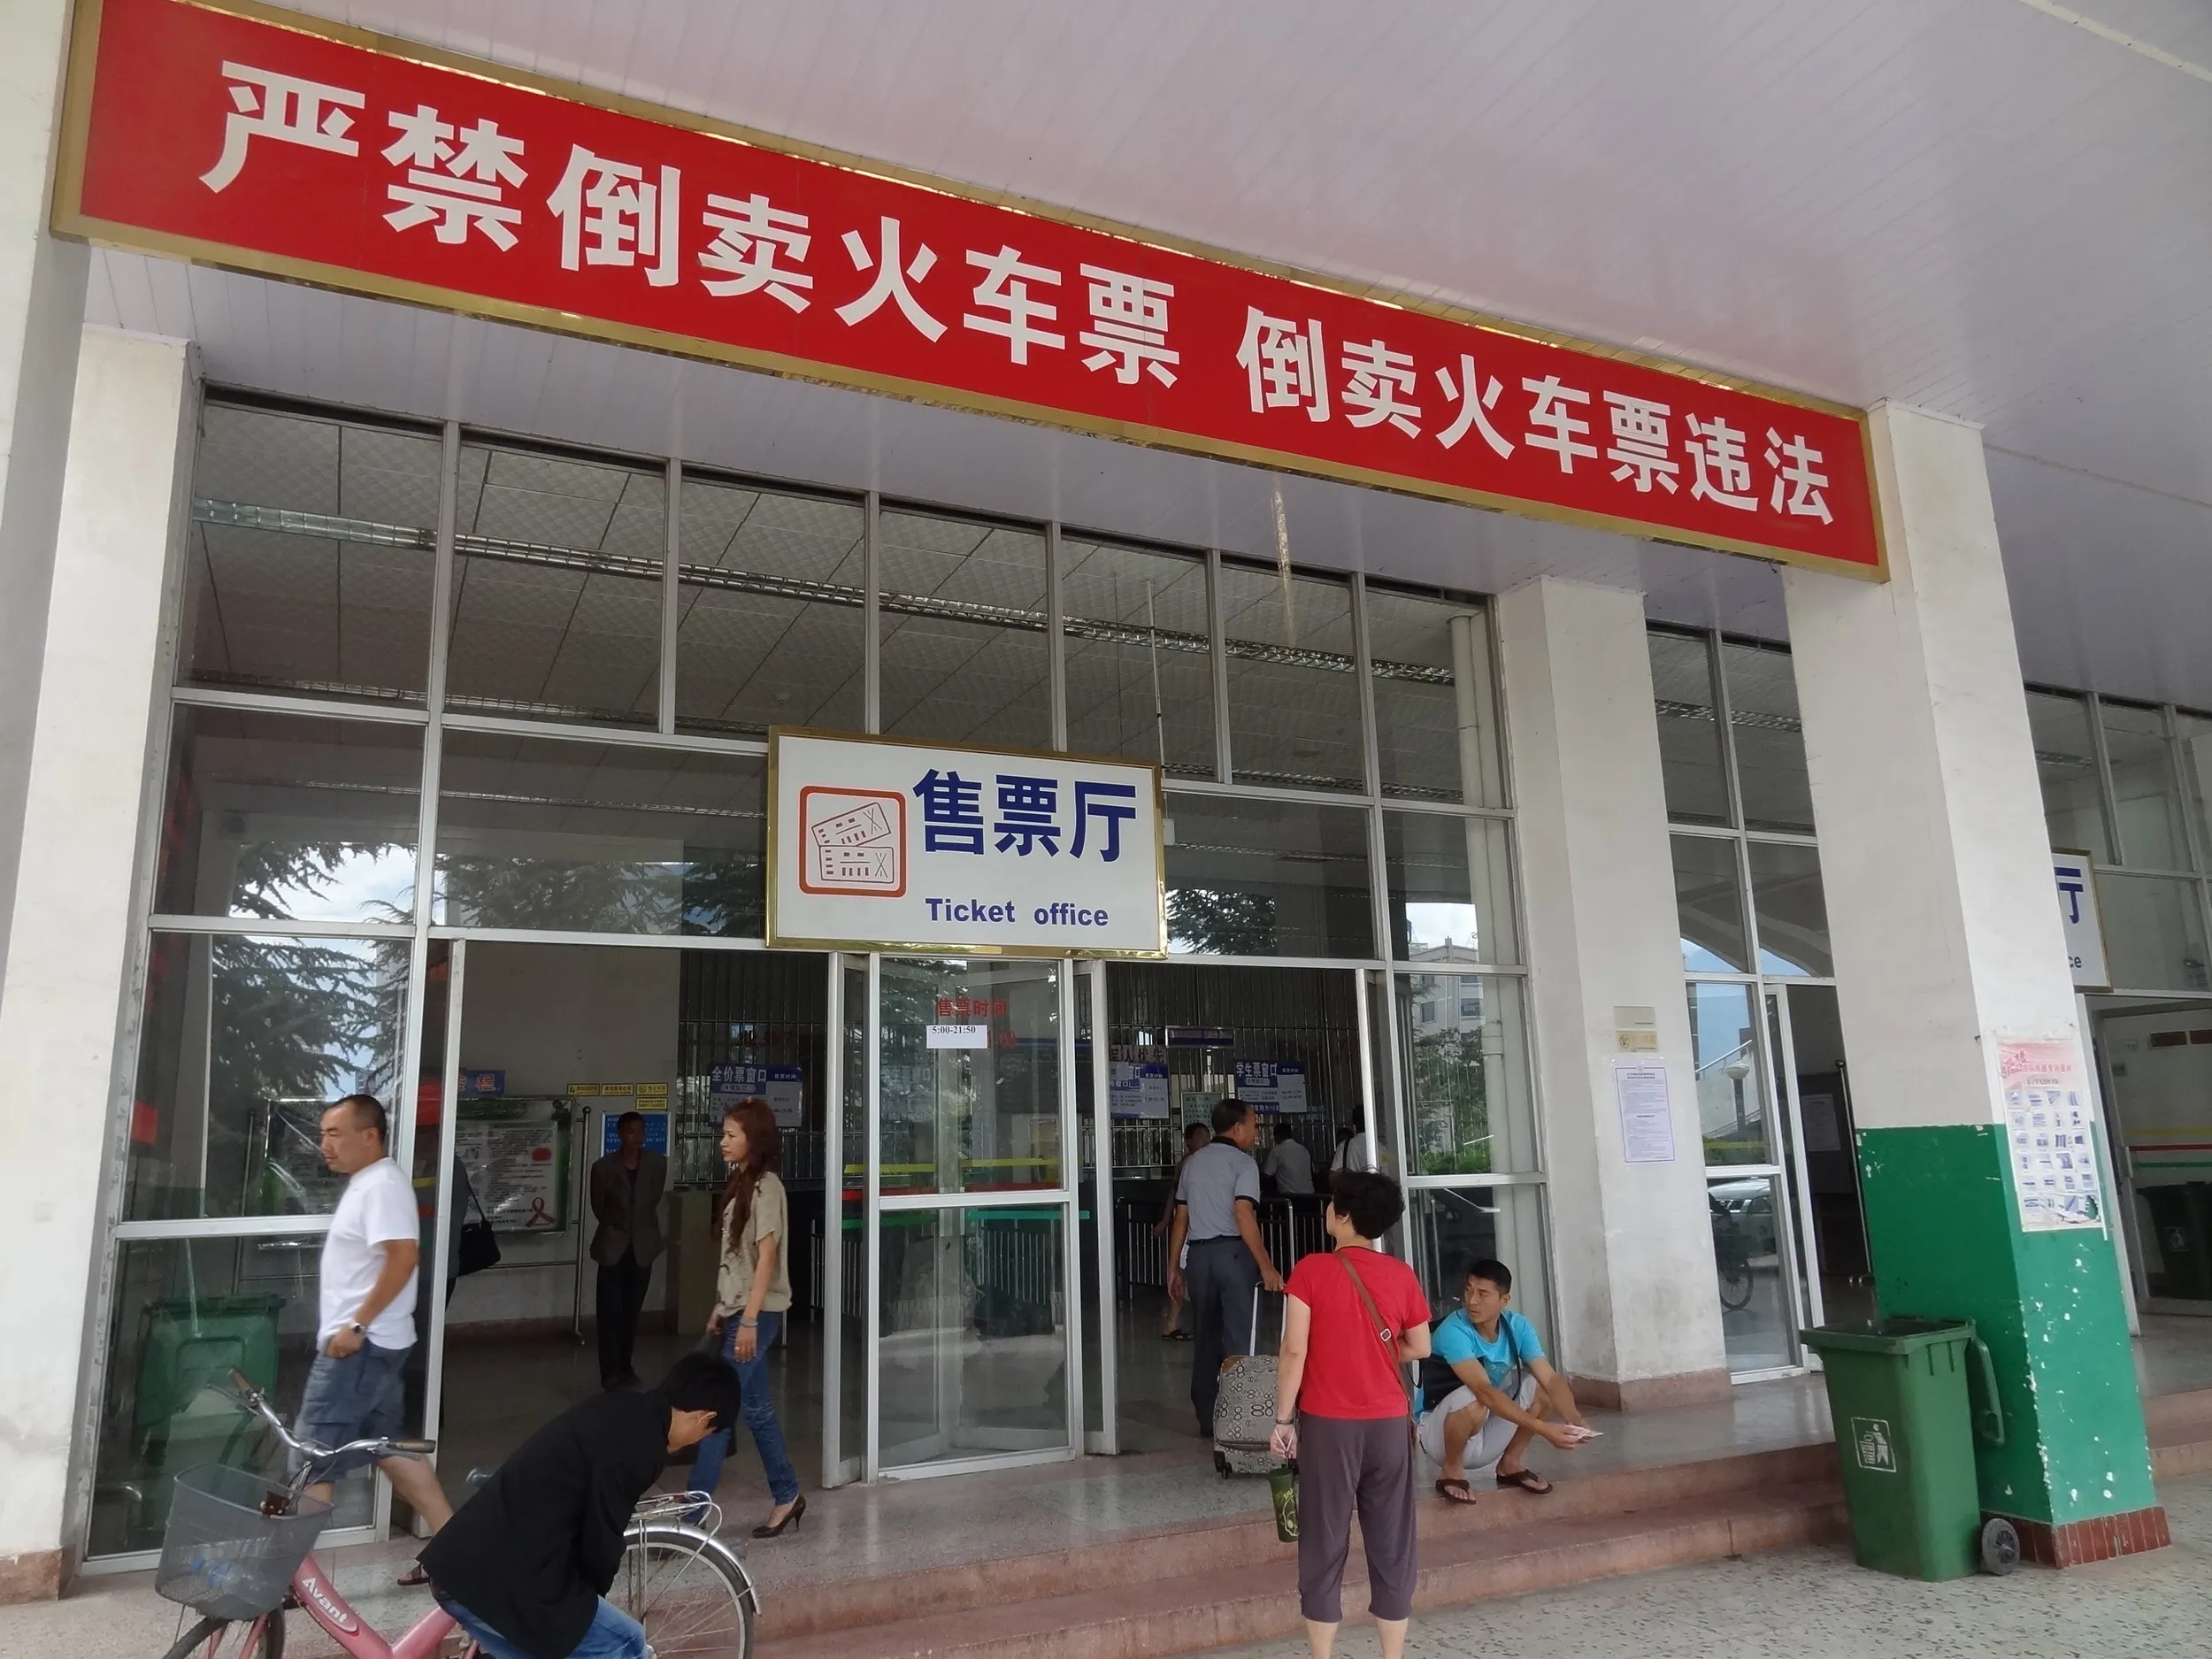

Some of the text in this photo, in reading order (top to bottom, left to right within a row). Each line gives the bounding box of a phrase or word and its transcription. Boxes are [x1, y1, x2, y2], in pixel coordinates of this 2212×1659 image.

[199, 60, 1833, 525] 严禁倒卖火车票 倒卖火车票违法
[912, 768, 1136, 862] 售票厅
[925, 897, 1109, 926] Ticket office
[937, 997, 1007, 1018] 售票时间
[932, 1025, 976, 1034] 5:00-21:50
[711, 1065, 767, 1083] 全价票窗口
[1236, 1062, 1278, 1078] 学生票窗口
[302, 1578, 348, 1624] Avant
